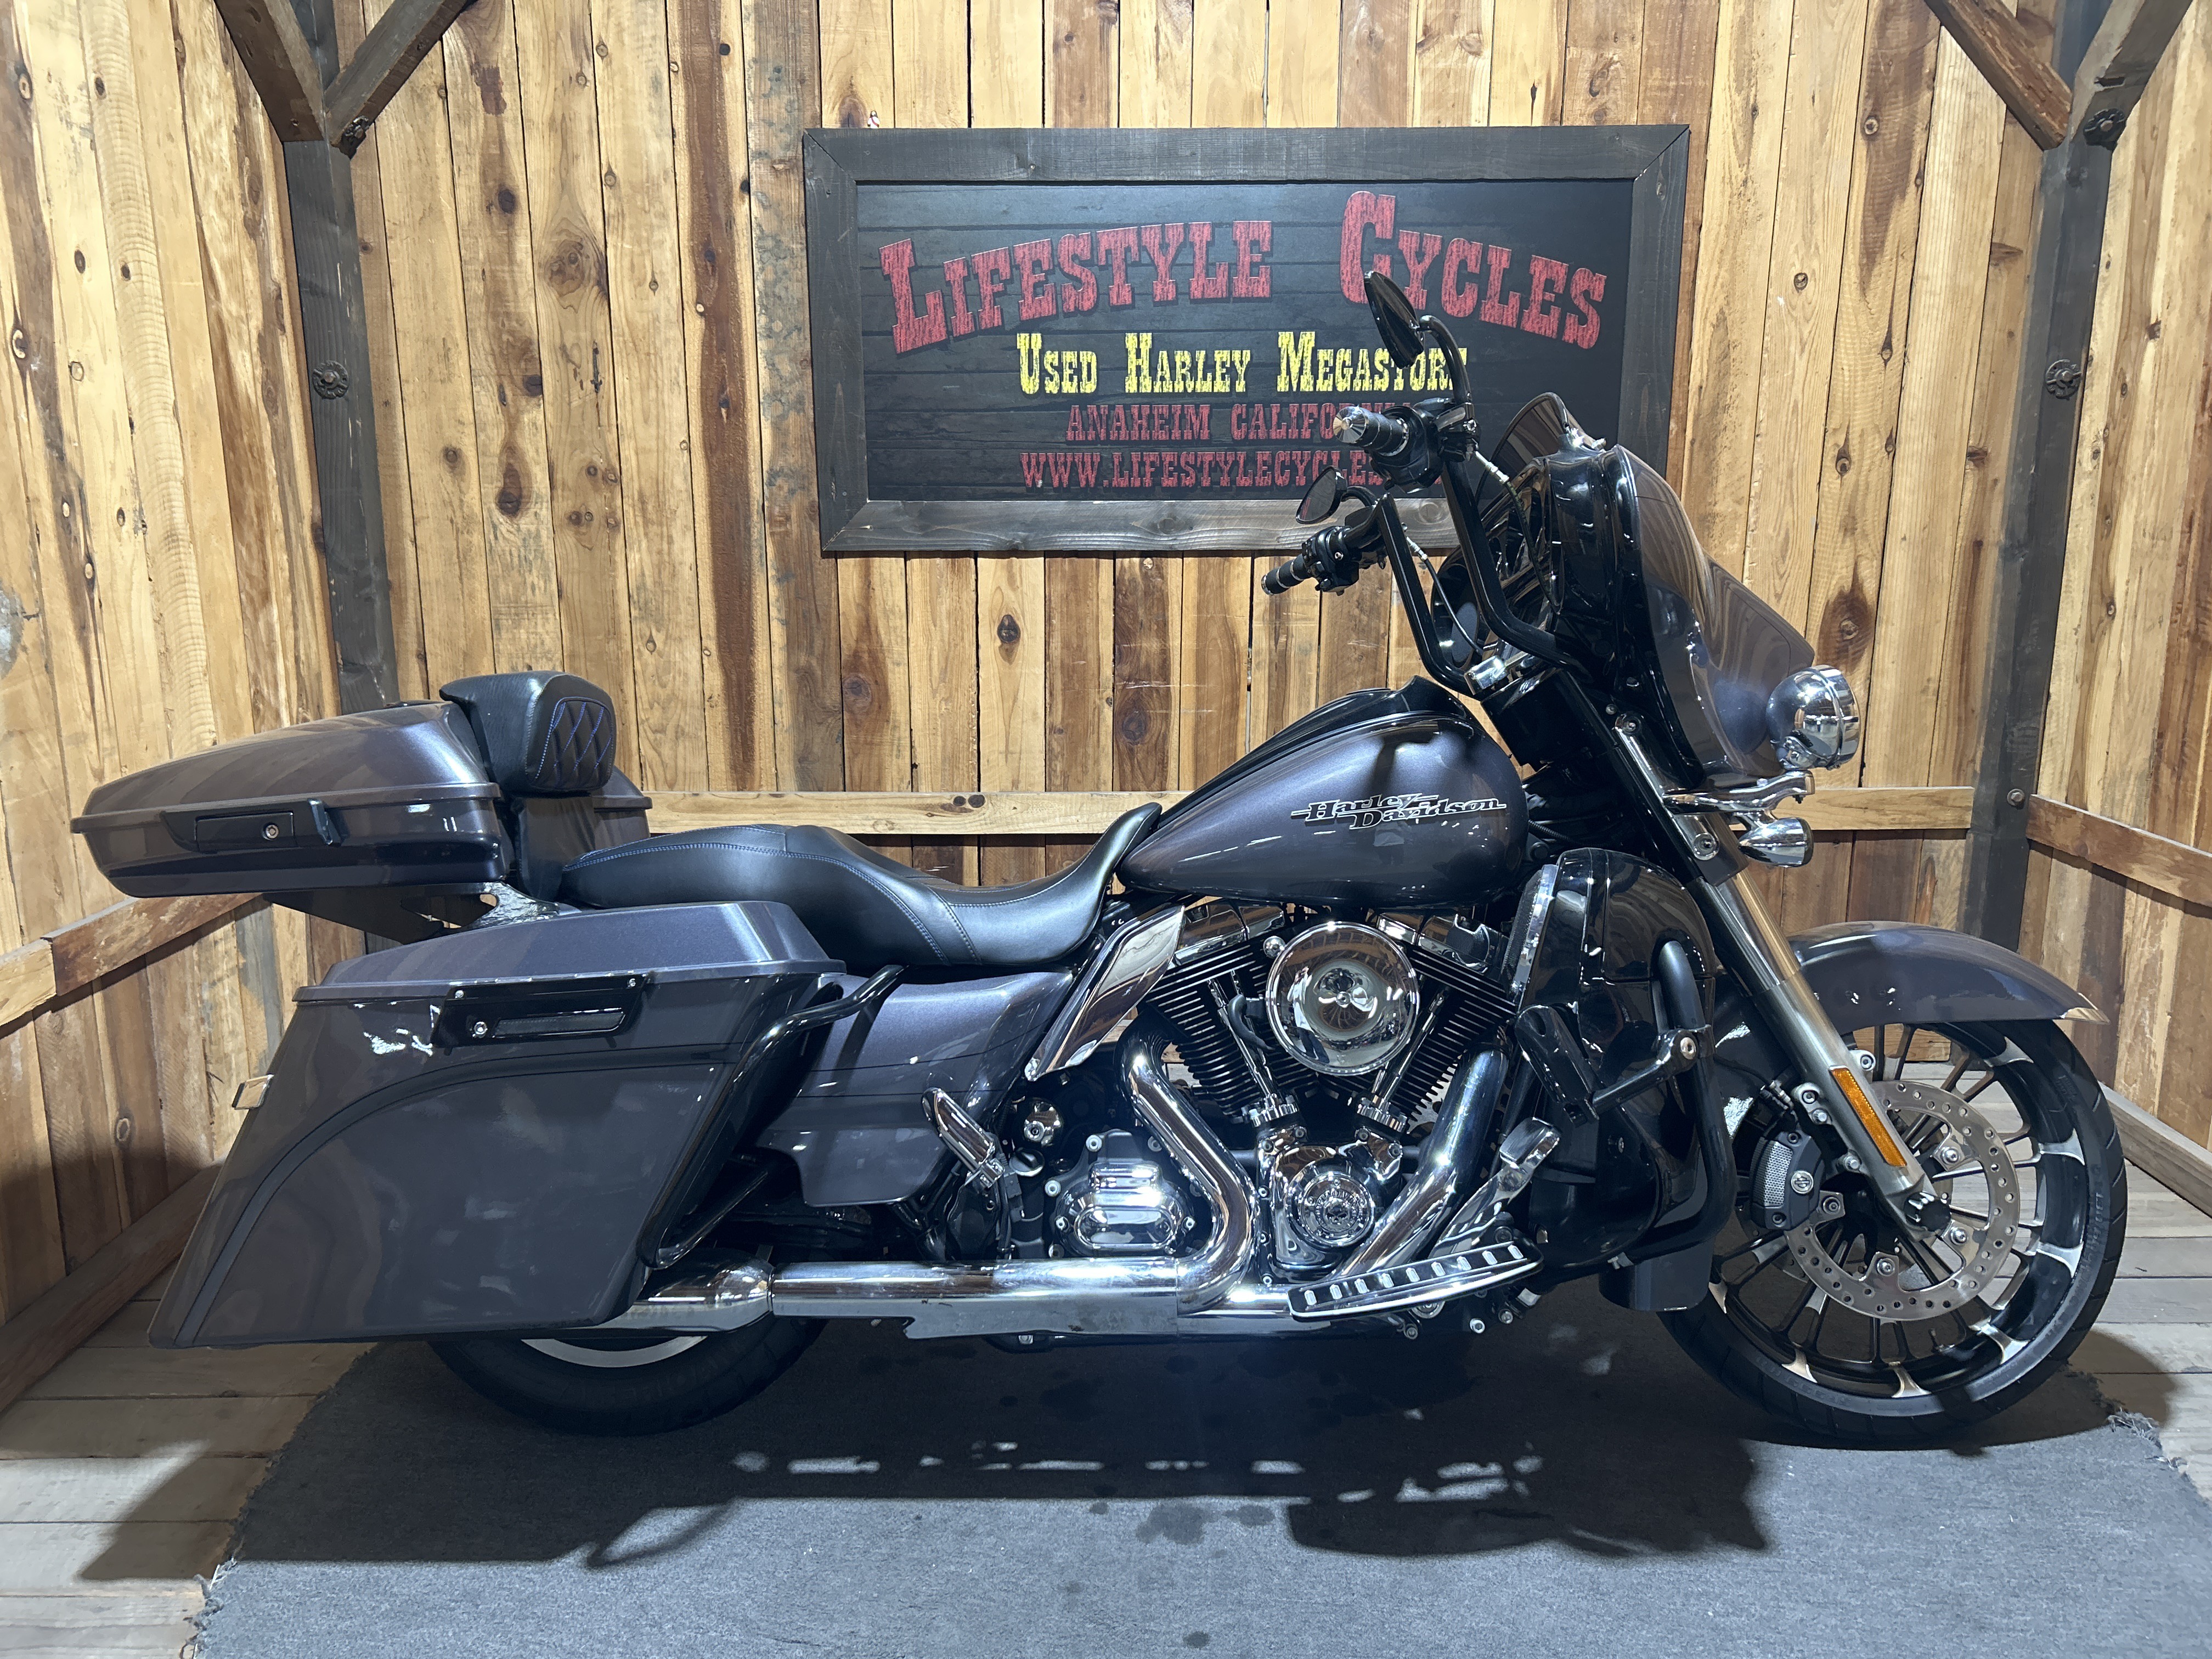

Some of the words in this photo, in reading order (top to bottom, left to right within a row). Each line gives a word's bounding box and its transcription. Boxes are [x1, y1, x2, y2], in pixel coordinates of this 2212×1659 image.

[879, 220, 1272, 354] LIFESTYLE
[1339, 190, 1607, 349] CYCLES
[1016, 332, 1097, 394] USED
[1125, 332, 1251, 393] HARLEY
[1276, 331, 1468, 392] MEGASOR
[1065, 404, 1211, 441] ANAHEIM
[1231, 402, 1411, 440] CALIFO
